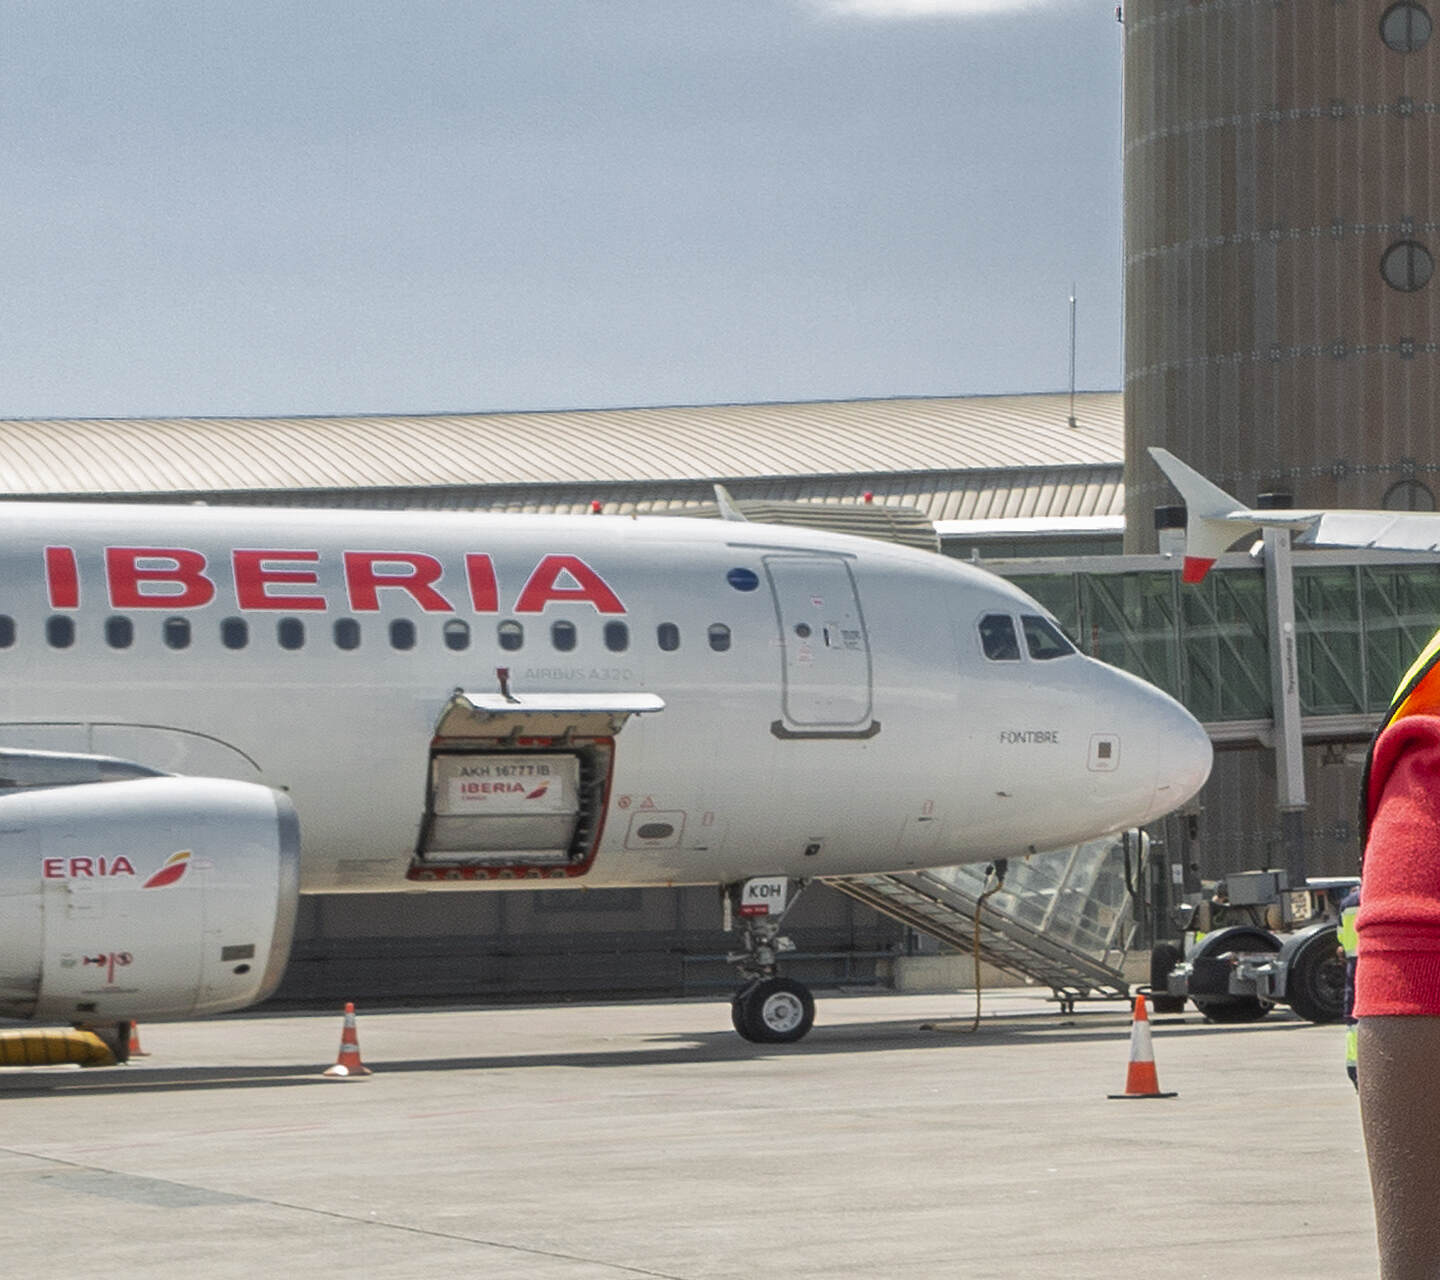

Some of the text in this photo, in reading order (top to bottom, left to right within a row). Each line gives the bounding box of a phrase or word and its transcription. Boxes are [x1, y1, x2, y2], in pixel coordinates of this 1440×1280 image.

[44, 545, 628, 614] IBERIA
[999, 730, 1059, 744] FONTIBRE
[460, 782, 525, 793] IBERIA
[43, 856, 136, 878] ERIA
